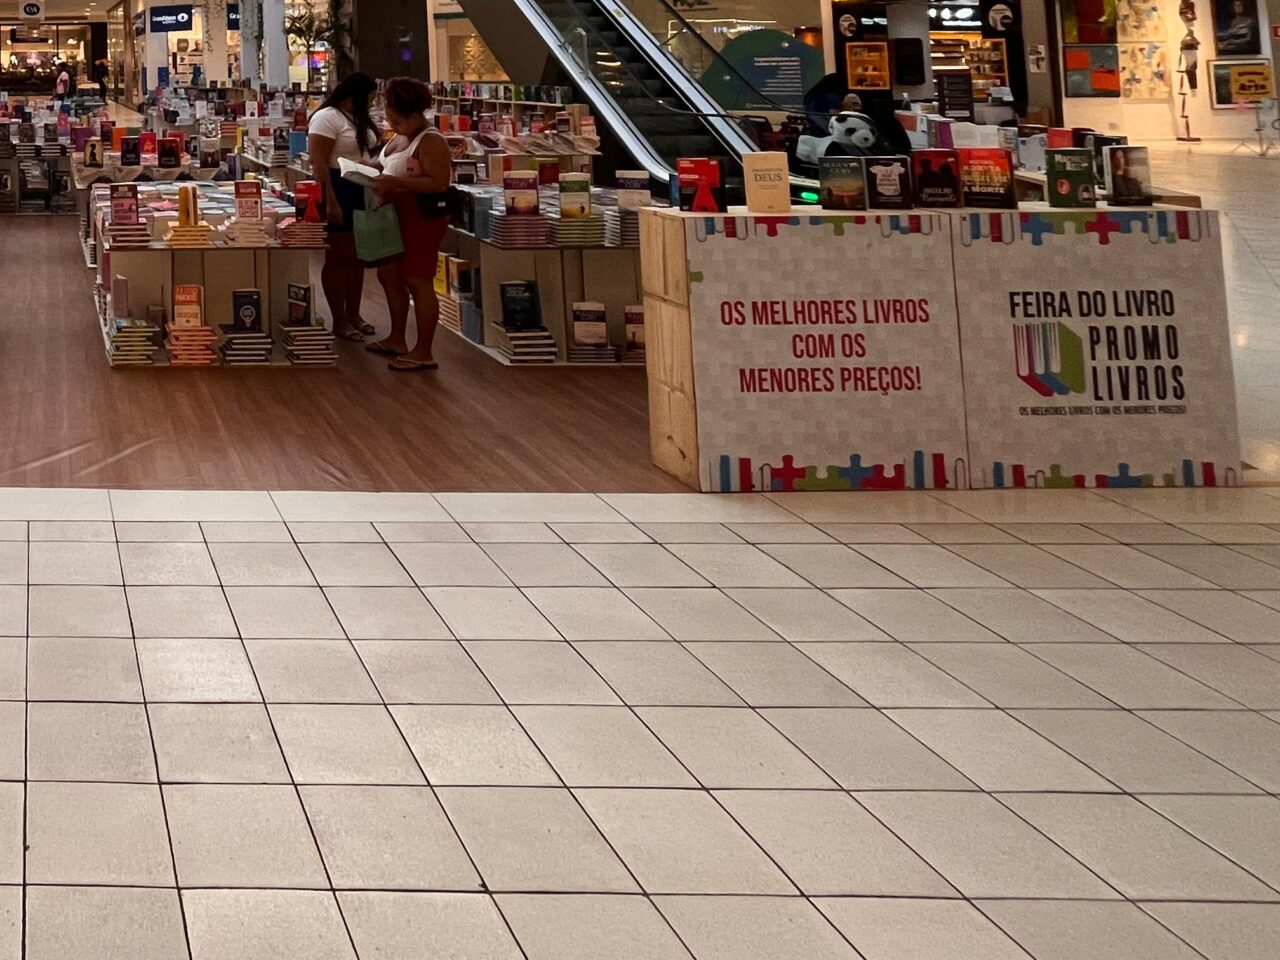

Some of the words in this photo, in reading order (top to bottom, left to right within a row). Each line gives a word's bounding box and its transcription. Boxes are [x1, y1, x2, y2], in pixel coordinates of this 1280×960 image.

[753, 172, 783, 182] DEUS
[720, 300, 746, 326] OS
[751, 299, 858, 326] MELHORES
[862, 298, 930, 324] LIVROS
[1009, 290, 1072, 318] FEIRA
[1077, 290, 1107, 317] DO
[1112, 289, 1175, 317] LIVRO
[792, 333, 835, 359] COM
[840, 332, 866, 358] OS
[1088, 324, 1179, 361] PROMO
[739, 366, 835, 393] MENORES
[839, 365, 923, 396] PREÇOS!
[1091, 364, 1186, 401] LIVROS
